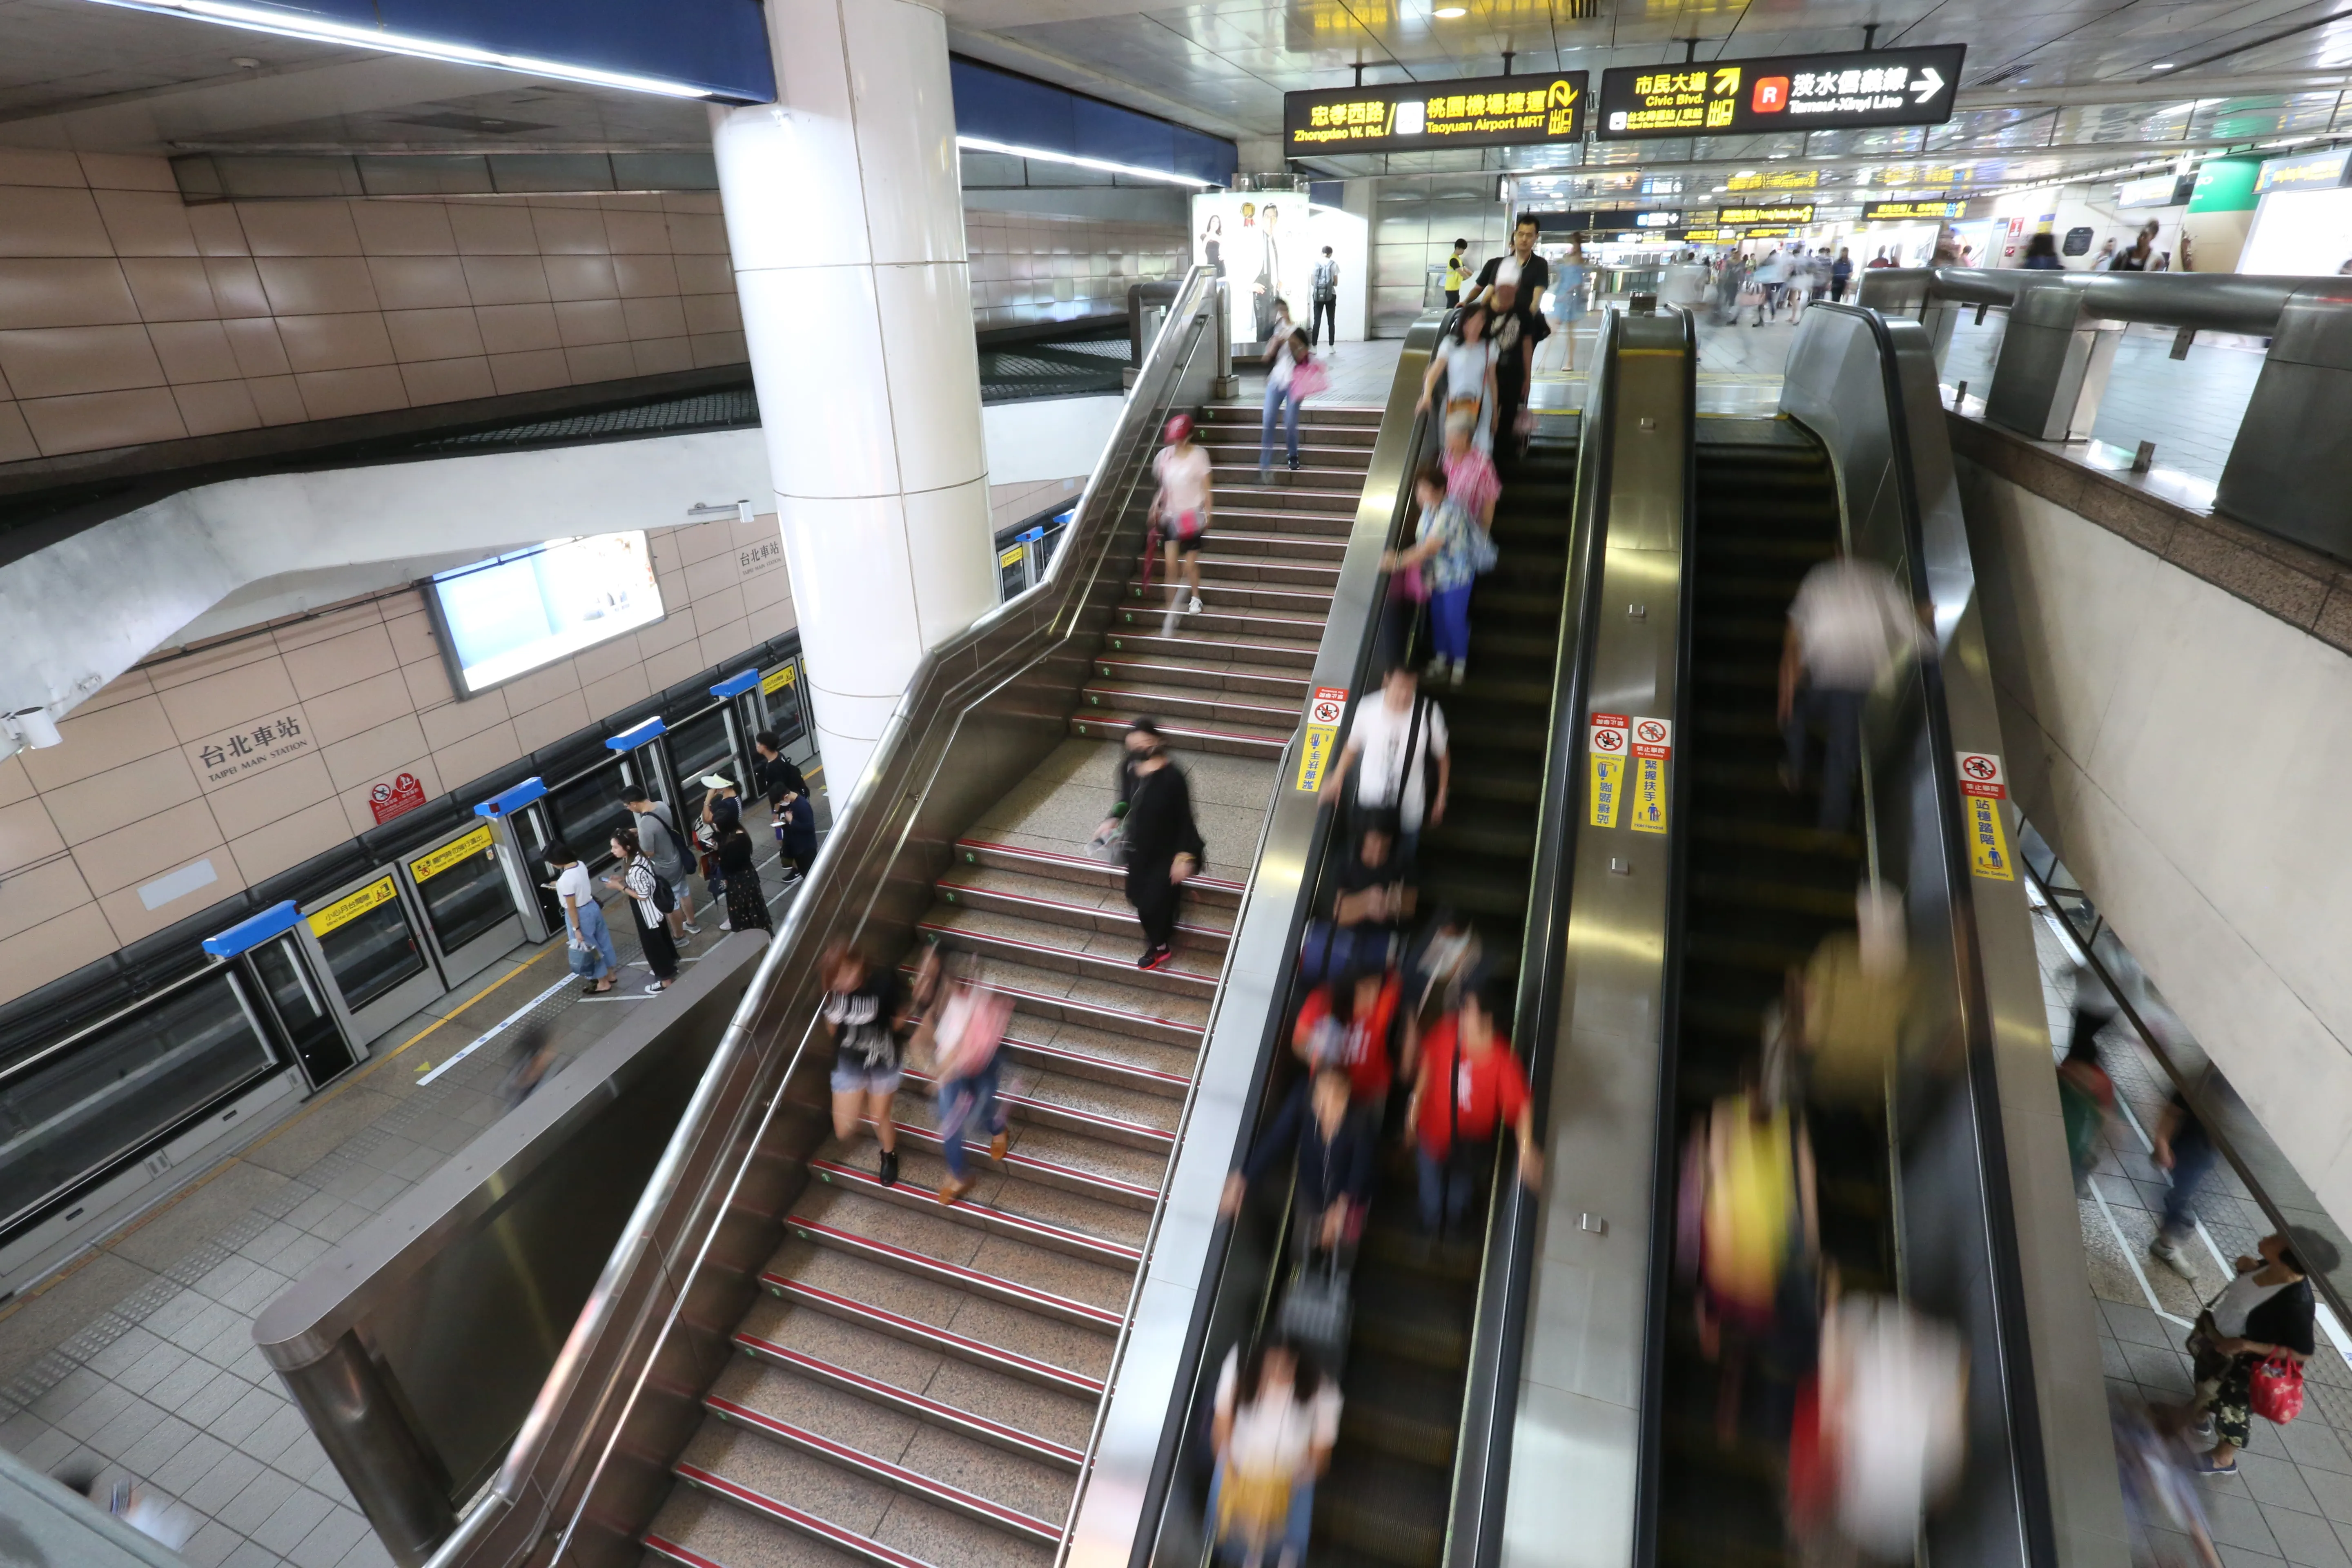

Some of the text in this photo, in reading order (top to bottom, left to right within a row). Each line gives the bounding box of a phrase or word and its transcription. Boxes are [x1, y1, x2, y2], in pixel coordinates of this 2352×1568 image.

[1635, 71, 1708, 94] 市民大道
[1791, 67, 1908, 97] 淡水信義線
[1427, 90, 1546, 118] 桃園機場捷運
[1645, 93, 1704, 107] Civic Blvd.
[1762, 87, 1777, 103] R
[1873, 95, 1903, 109] Line
[1311, 101, 1385, 126] 忠孝西路
[1426, 115, 1545, 135] Taoyuan Airport MRT
[1548, 109, 1572, 135] 出口
[1294, 125, 1384, 142] Zhongxiao W. Rd.
[740, 541, 779, 566] 台北車站
[199, 717, 301, 768] 台北車站
[208, 739, 308, 782] TAIPEI MAIN STATION
[1302, 751, 1321, 790] 緊握扶手
[1644, 760, 1657, 801] 緊握扶手
[532, 975, 576, 1004] Waiting Lin
